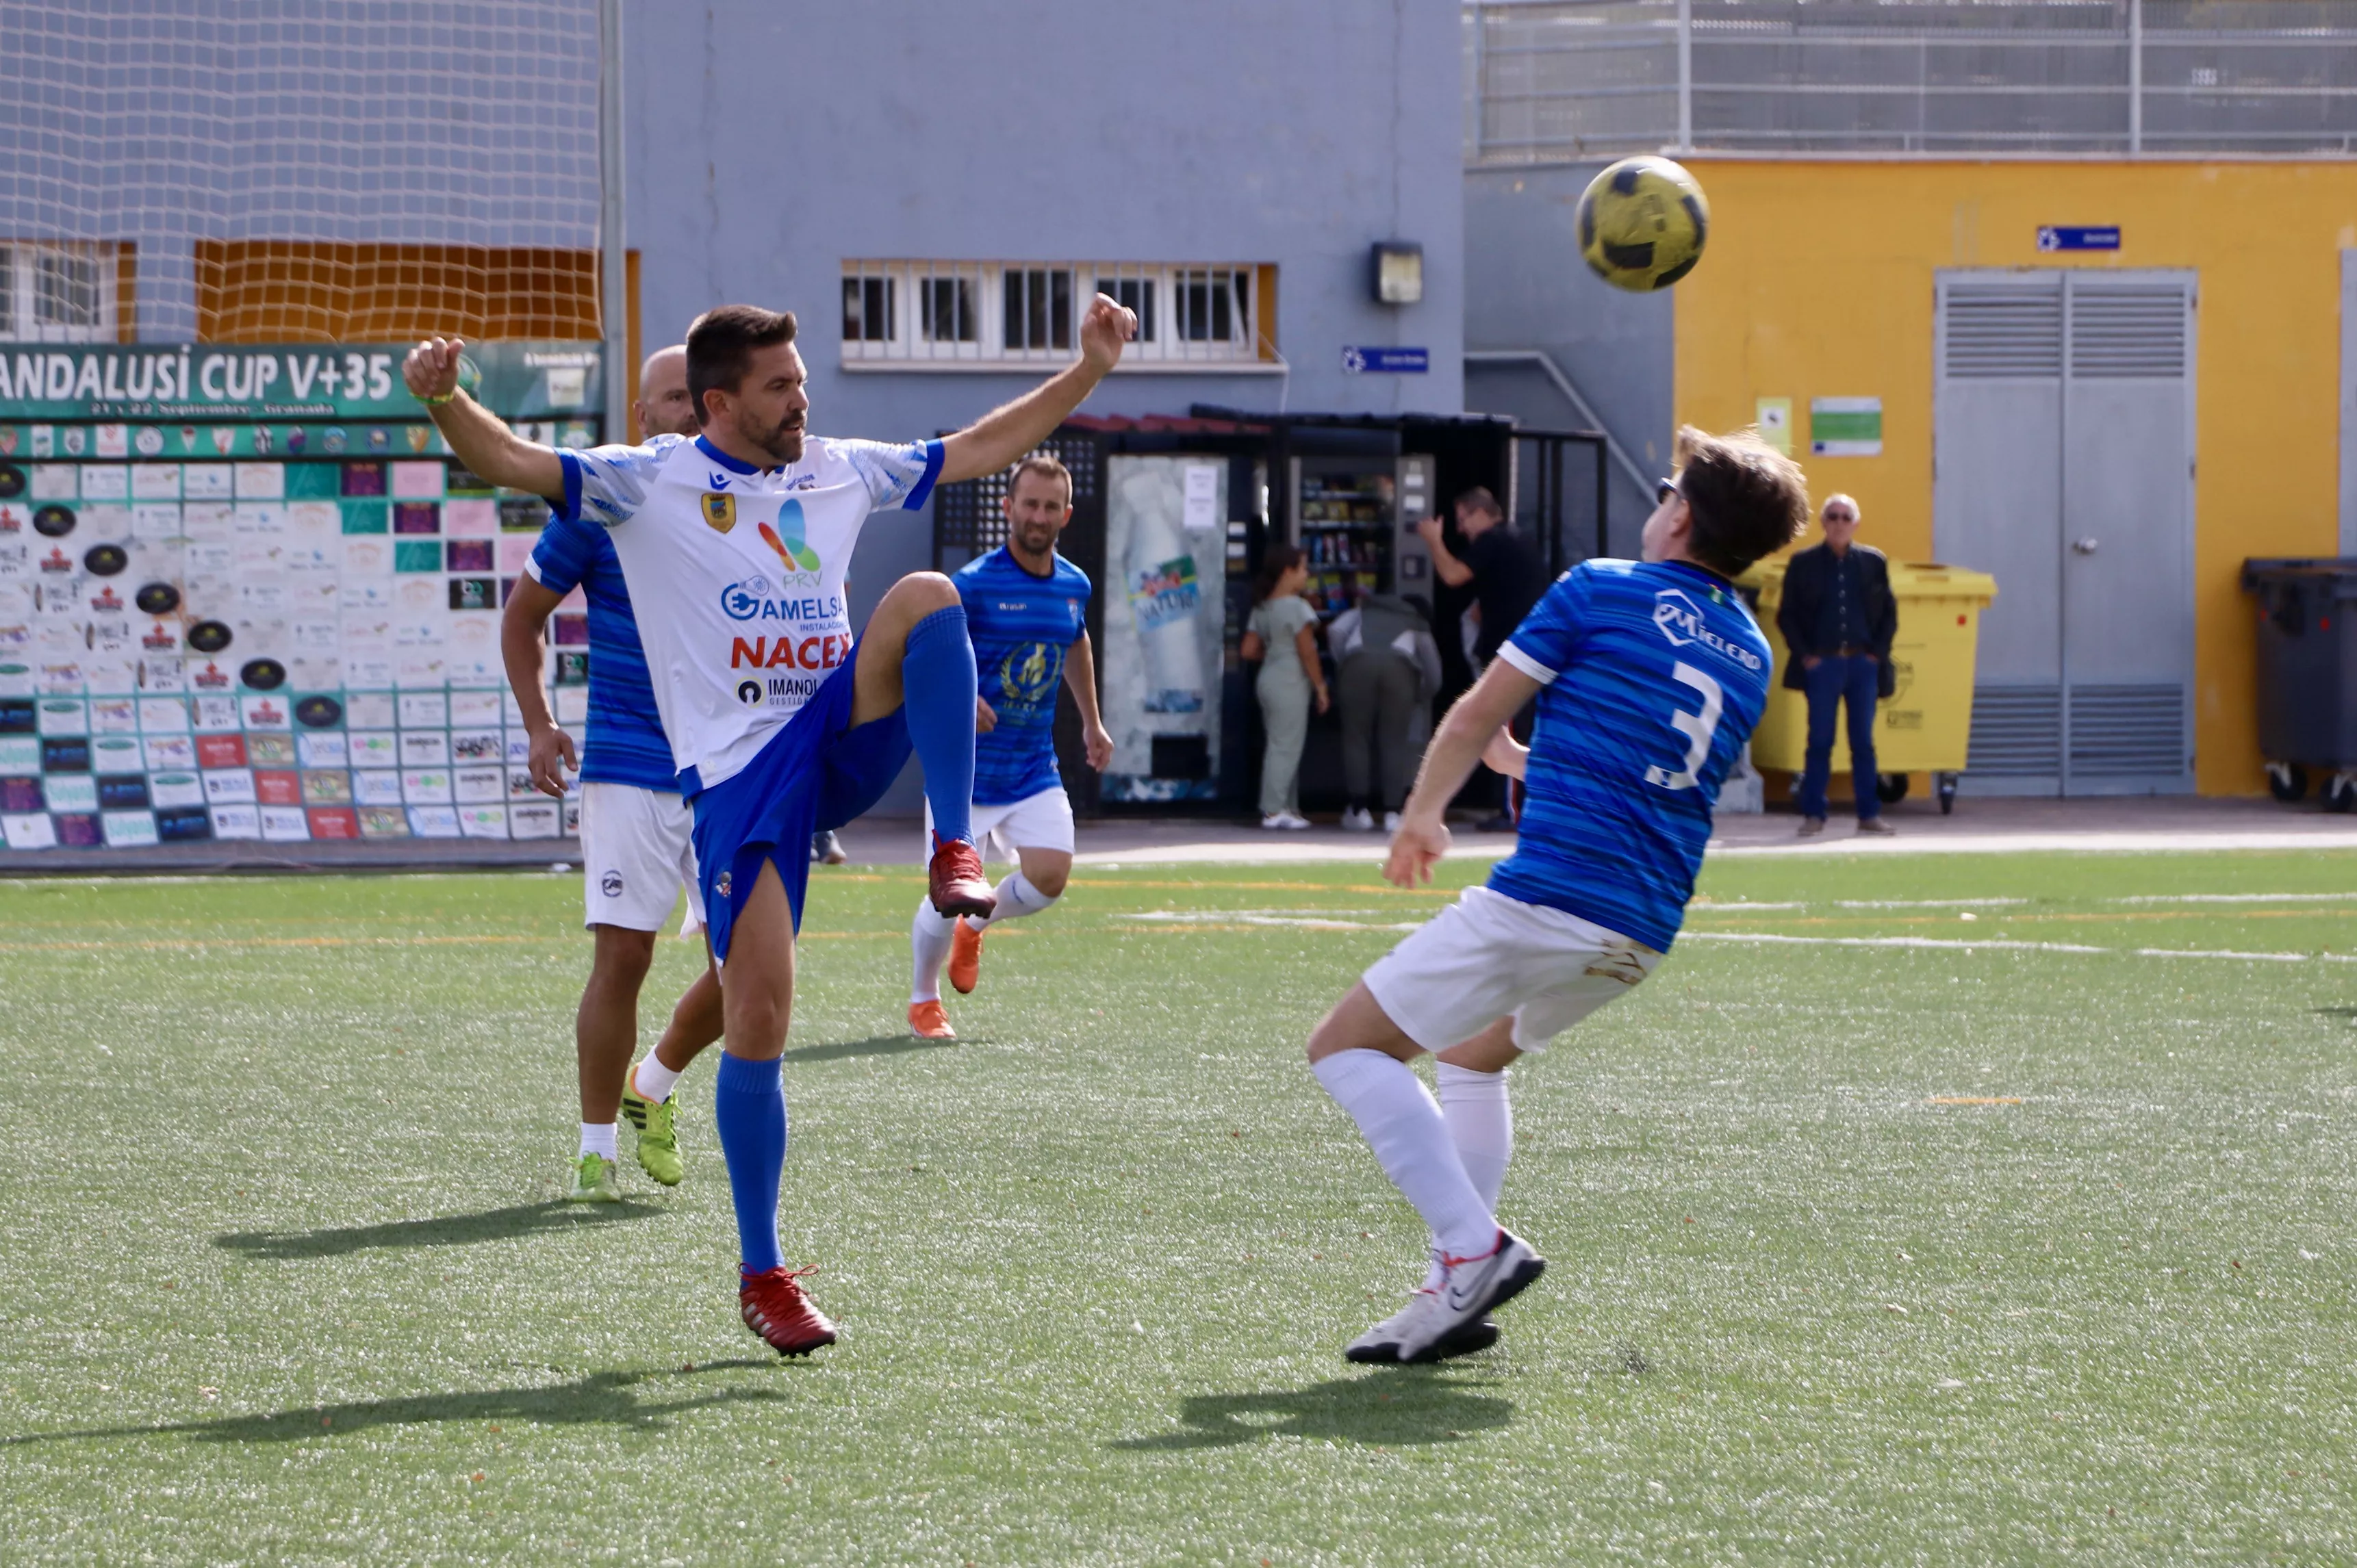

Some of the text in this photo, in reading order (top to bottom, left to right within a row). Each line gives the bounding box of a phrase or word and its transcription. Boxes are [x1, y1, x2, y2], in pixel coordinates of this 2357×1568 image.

[201, 353, 278, 400] CUP
[286, 352, 392, 400] V+35
[158, 402, 251, 418] Septiembre
[264, 402, 334, 415] Granada
[782, 570, 822, 589] PRV
[731, 632, 850, 670] NACEX
[1644, 660, 1724, 791] 3
